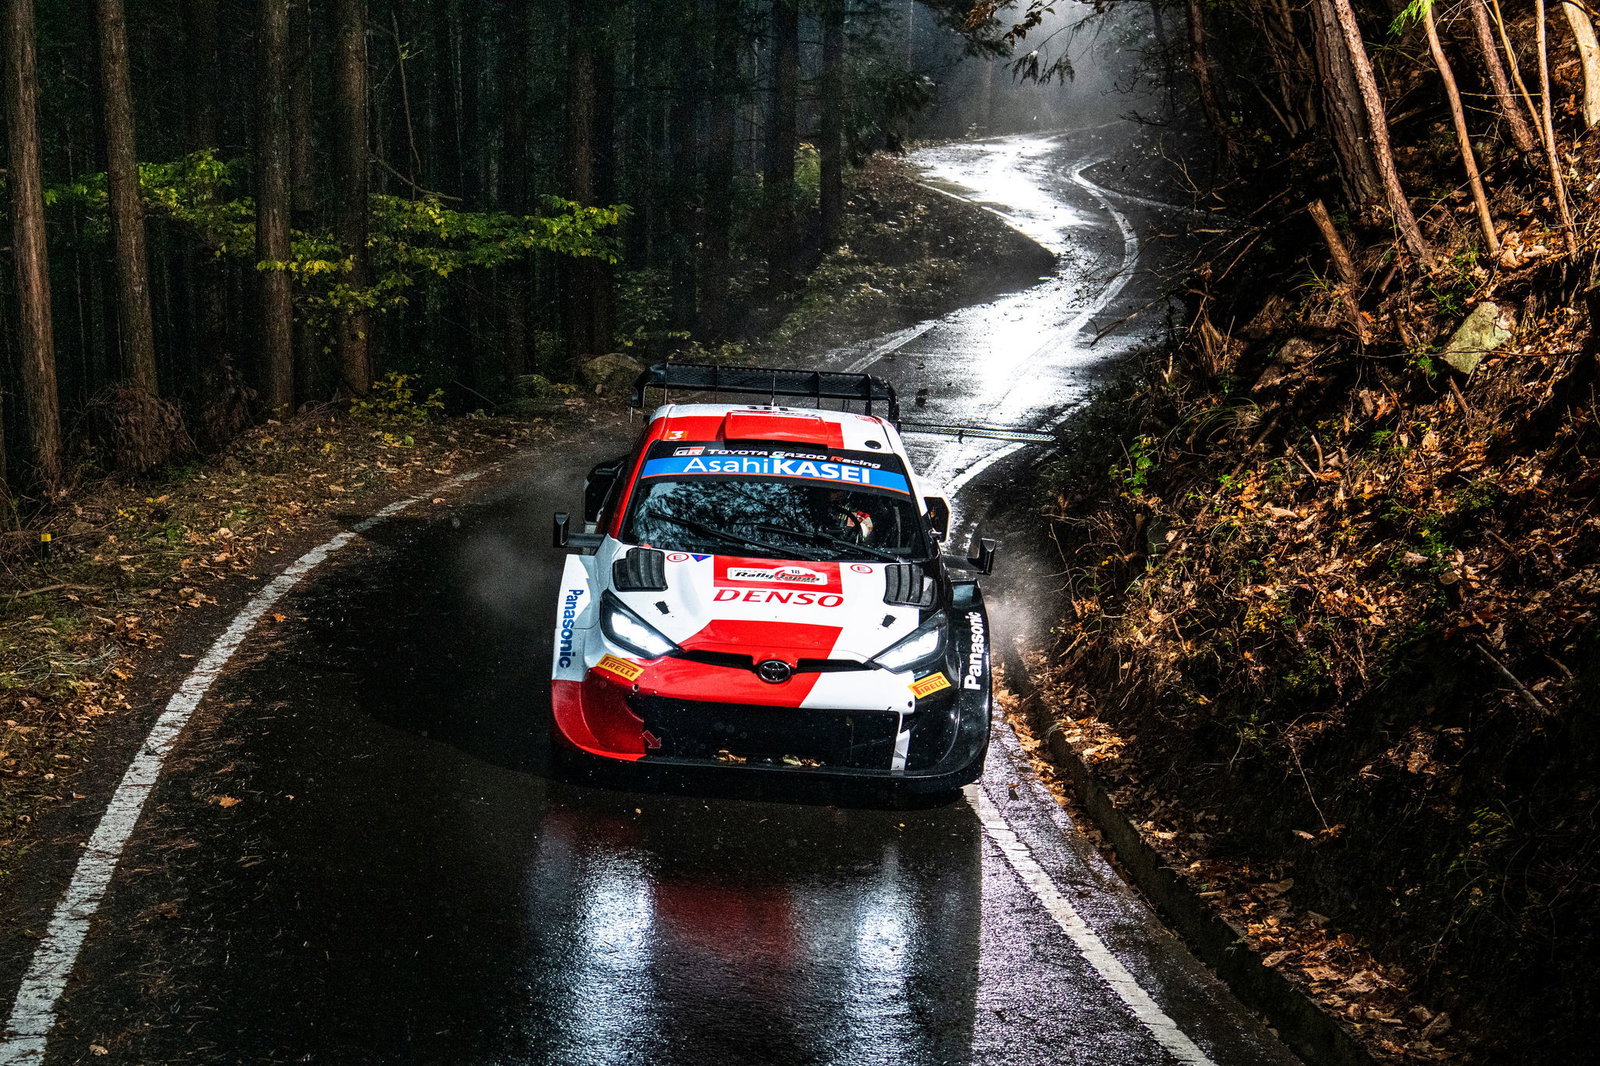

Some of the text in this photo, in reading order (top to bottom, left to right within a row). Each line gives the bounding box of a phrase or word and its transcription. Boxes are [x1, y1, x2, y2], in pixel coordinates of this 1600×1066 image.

[668, 430, 684, 440] 3
[674, 447, 704, 456] GR
[707, 449, 881, 469] TOYOTA GAZOO Racing
[734, 571, 774, 580] Rally
[713, 589, 844, 608] DENSO
[559, 589, 584, 669] Panasonic
[964, 611, 985, 690] Panasonic
[600, 656, 639, 678] PIRELLI
[911, 675, 947, 696] PIRELLI
